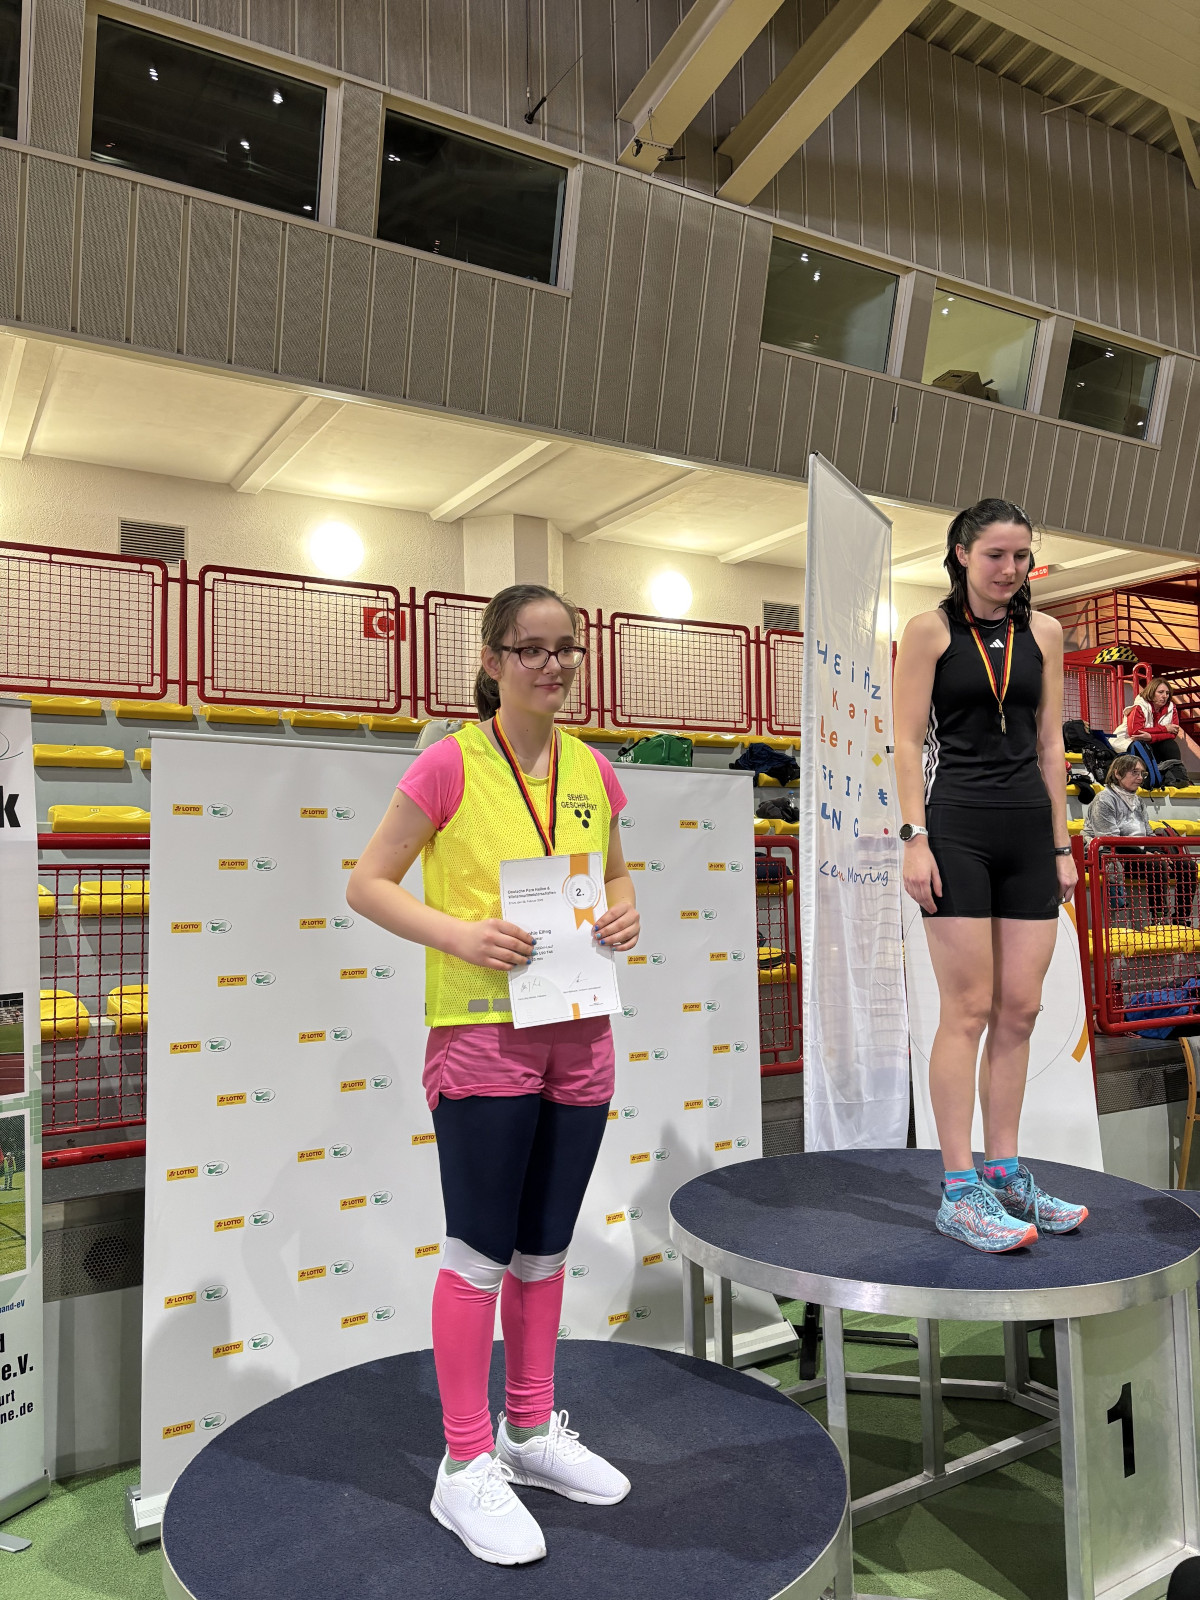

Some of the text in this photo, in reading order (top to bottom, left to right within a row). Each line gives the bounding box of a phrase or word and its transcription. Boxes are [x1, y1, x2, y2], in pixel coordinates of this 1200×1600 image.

[575, 887, 585, 897] 2.
[348, 1198, 364, 1206] LOTTO
[224, 1219, 242, 1227] LOTTO
[307, 1268, 324, 1276] LOTTO
[175, 1294, 194, 1303] LOTTO
[349, 1315, 366, 1323] LOTTO
[222, 1344, 240, 1353] LOTTO
[1, 1353, 34, 1381] e.V.
[173, 1423, 192, 1433] LOTTO
[1107, 1382, 1136, 1479] 1
